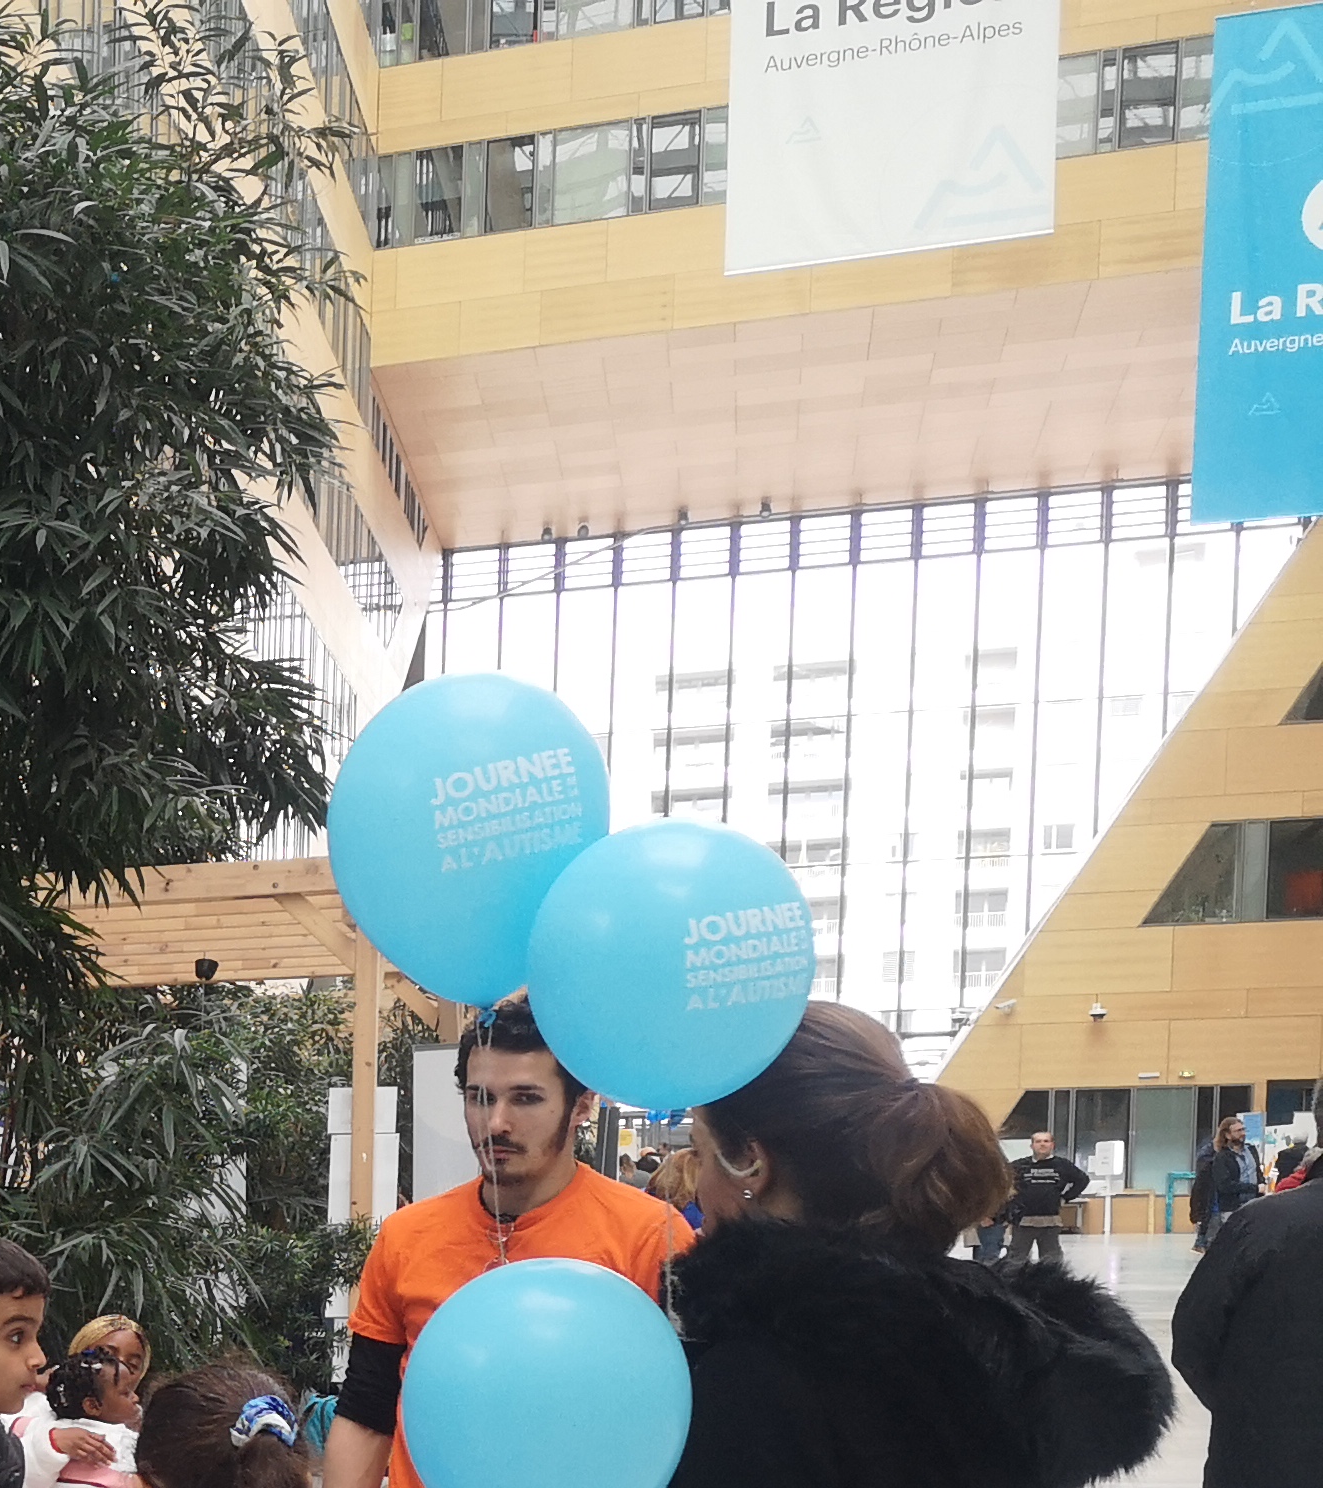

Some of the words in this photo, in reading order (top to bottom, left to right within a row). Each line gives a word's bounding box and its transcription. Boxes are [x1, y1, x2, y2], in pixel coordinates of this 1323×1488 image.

[765, 1, 820, 37] La
[764, 21, 1024, 74] Auvergne-Rhône-Alpes
[1230, 291, 1283, 325] La
[1228, 333, 1323, 356] Auvergne
[430, 748, 576, 806] JOURNEE
[434, 779, 564, 829] MONDIALE
[684, 901, 805, 945] JOURNEE
[685, 933, 798, 969] MONDIALE
